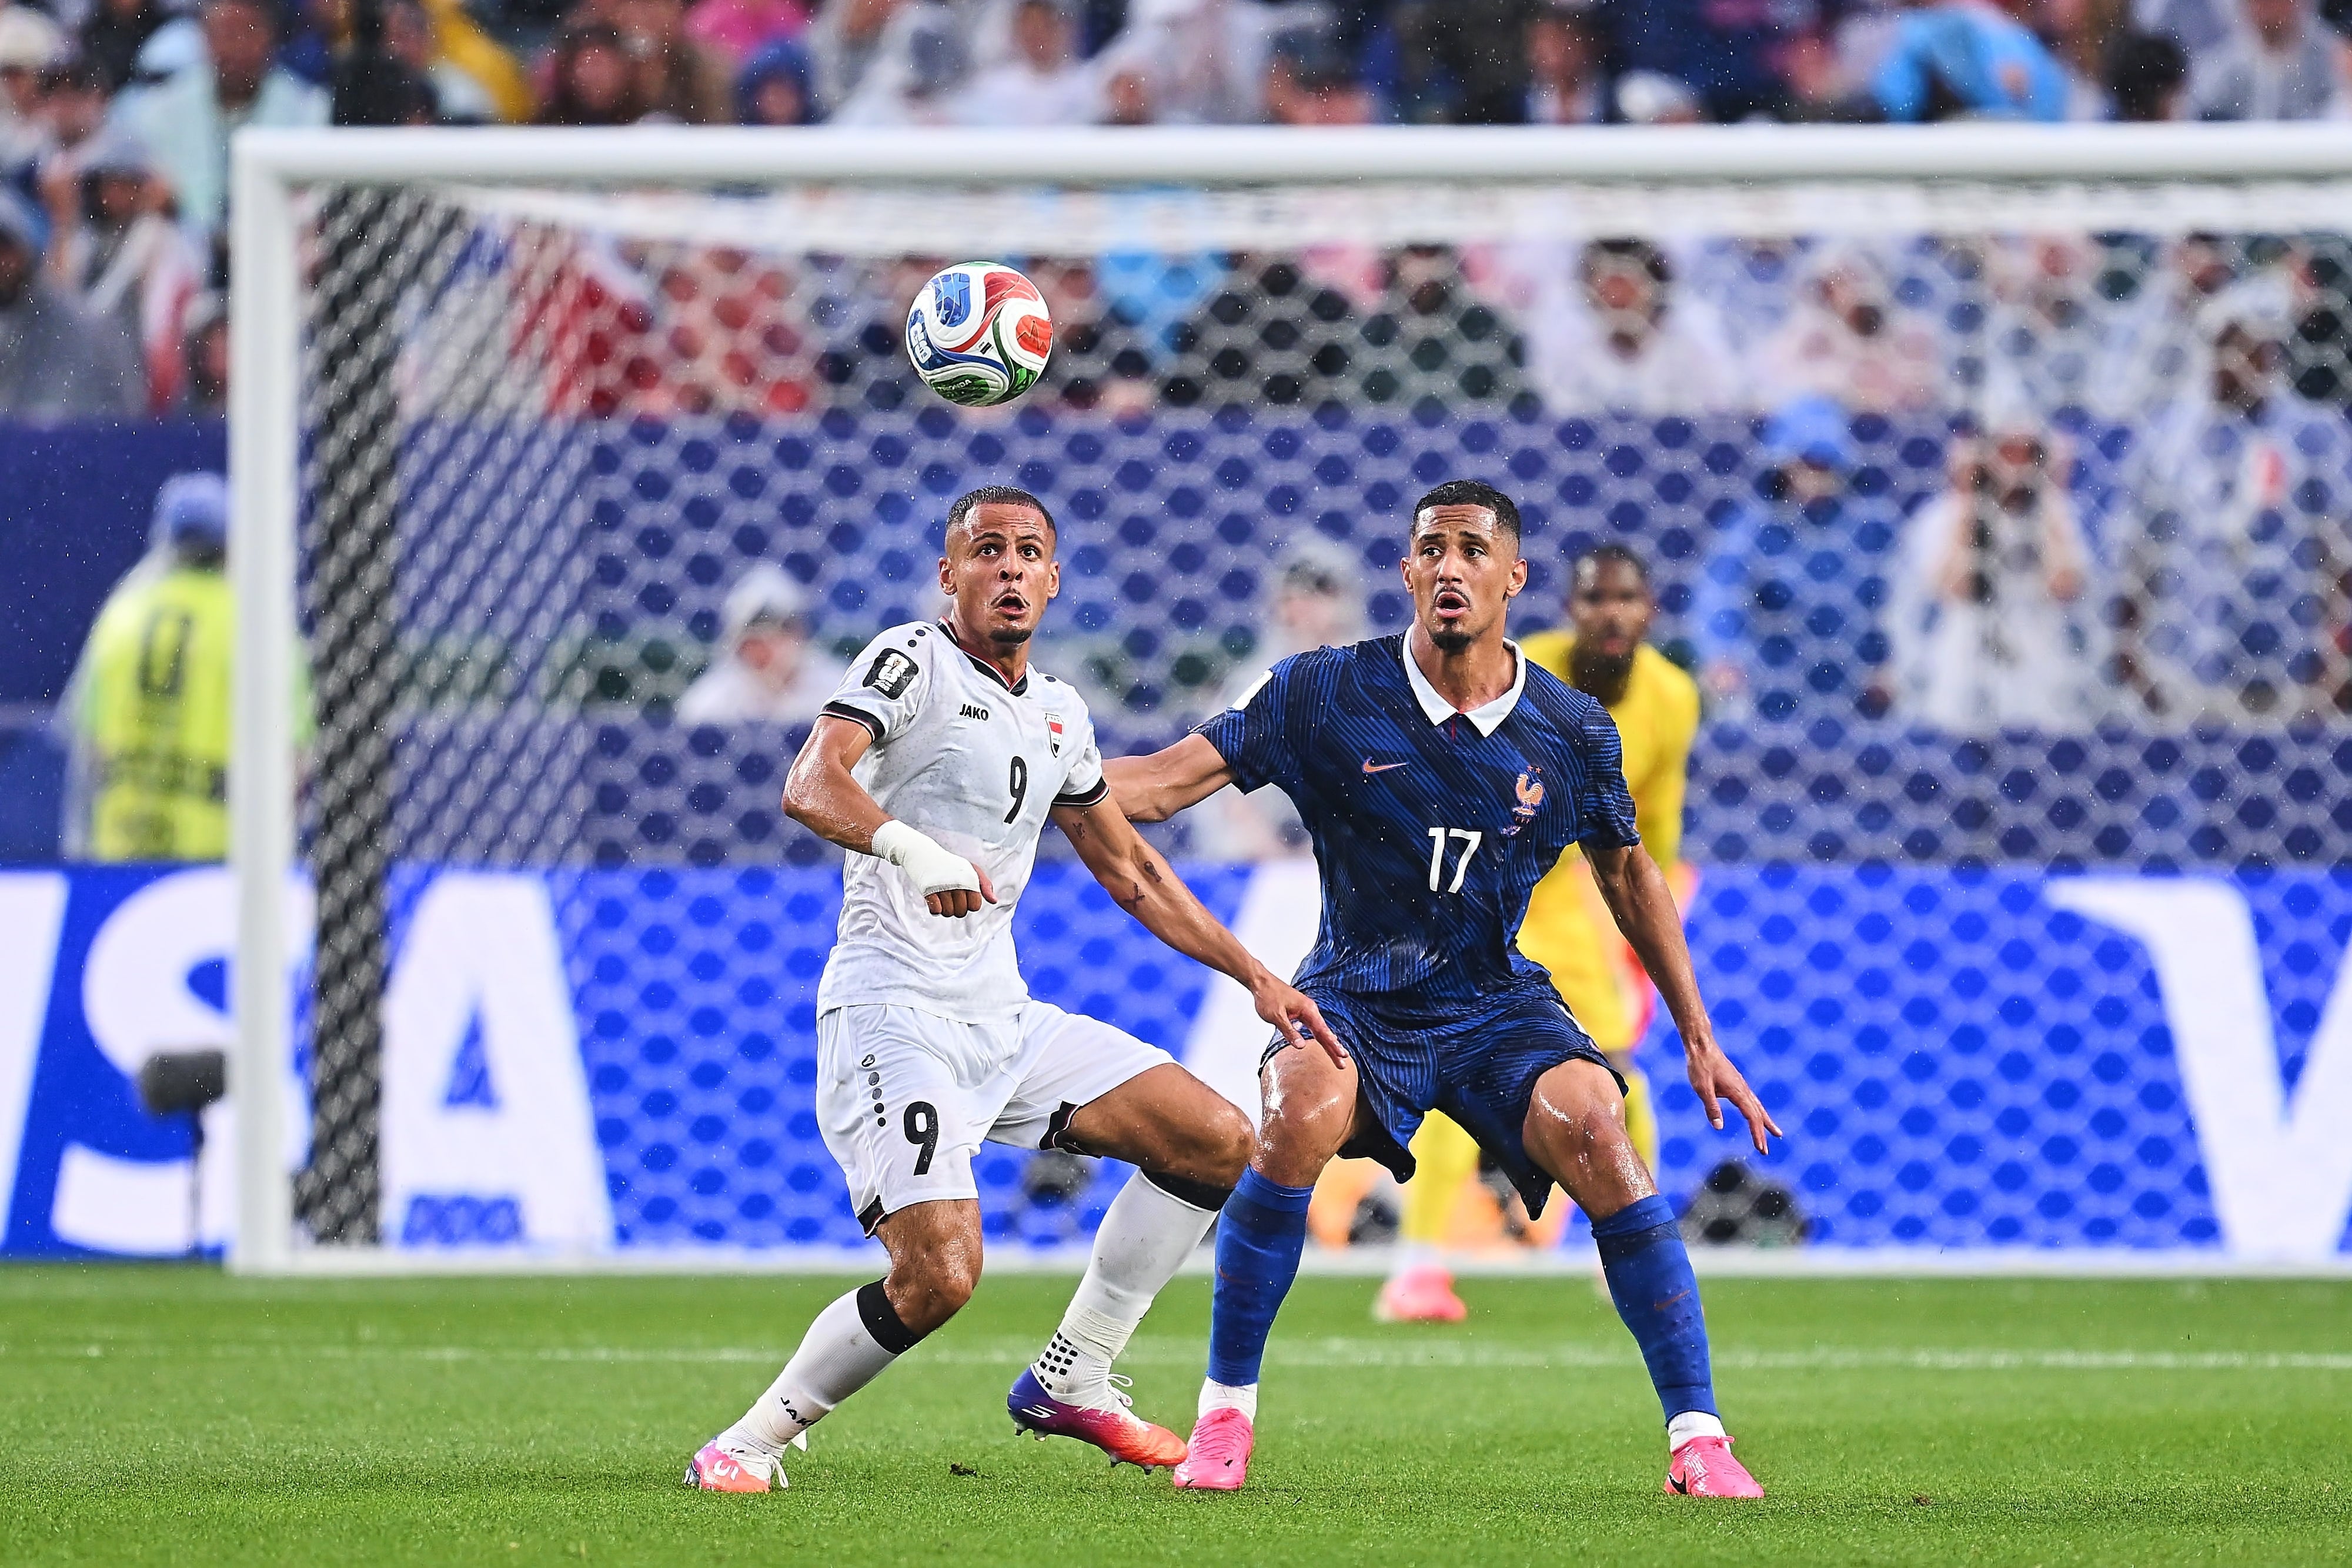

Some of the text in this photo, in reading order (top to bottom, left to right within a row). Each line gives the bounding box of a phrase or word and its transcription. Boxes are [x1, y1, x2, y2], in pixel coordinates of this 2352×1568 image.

[959, 704, 989, 721] JAKO
[1004, 756, 1027, 824] 9
[1428, 827, 1482, 894] 17
[904, 1101, 938, 1176] 9
[780, 1397, 821, 1426] JAK
